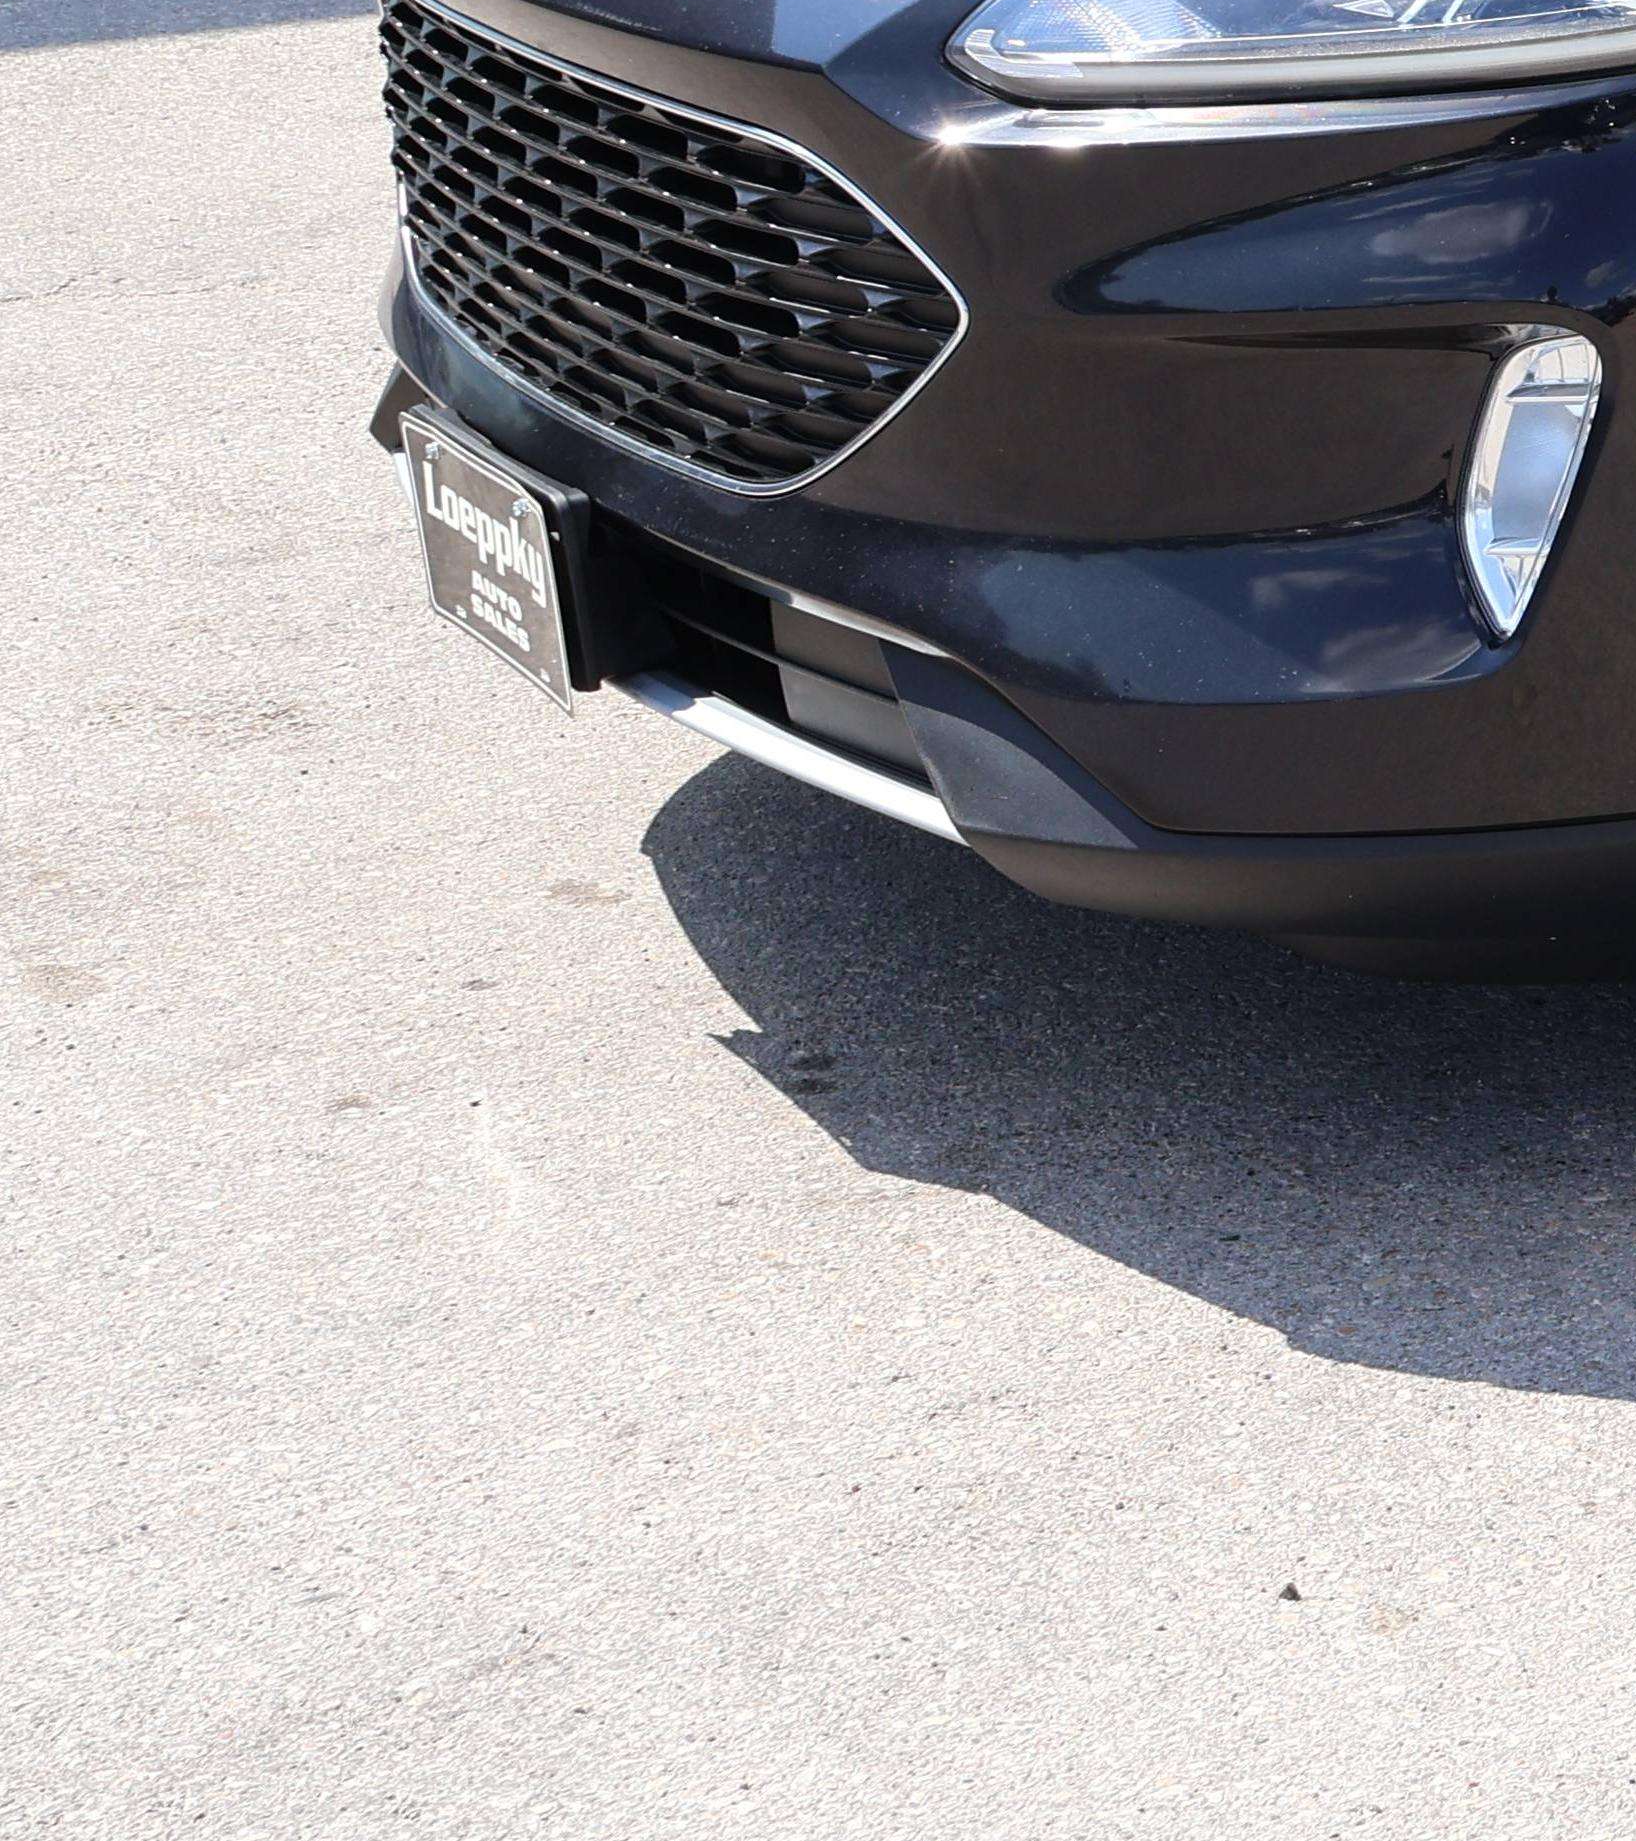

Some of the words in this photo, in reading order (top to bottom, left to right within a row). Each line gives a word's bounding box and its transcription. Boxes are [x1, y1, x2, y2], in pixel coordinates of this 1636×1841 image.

[422, 460, 547, 609] Loeppky
[470, 593, 531, 653] SALES
[471, 570, 523, 622] AUTO
